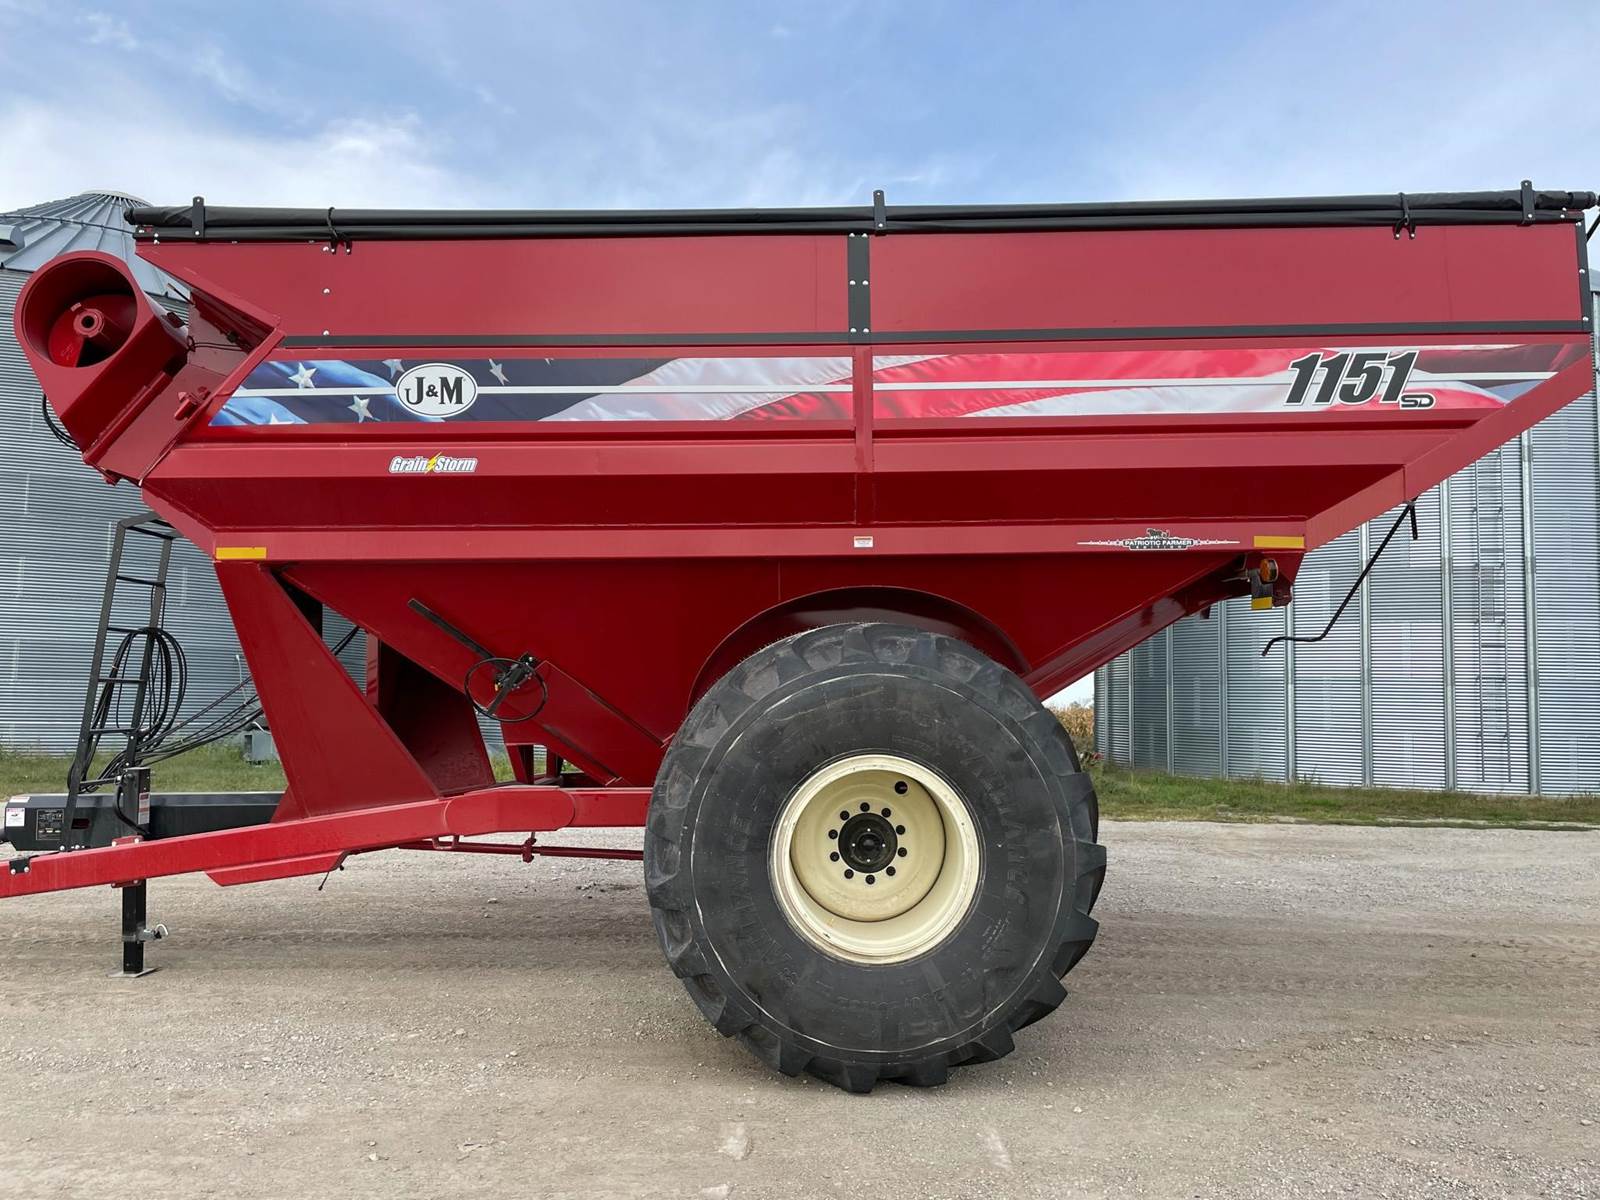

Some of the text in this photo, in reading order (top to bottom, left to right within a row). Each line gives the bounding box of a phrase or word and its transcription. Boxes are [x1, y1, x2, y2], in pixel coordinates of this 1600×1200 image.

[405, 376, 464, 405] J&M
[1284, 351, 1435, 409] 1151 SD
[390, 456, 477, 473] Grain Storm
